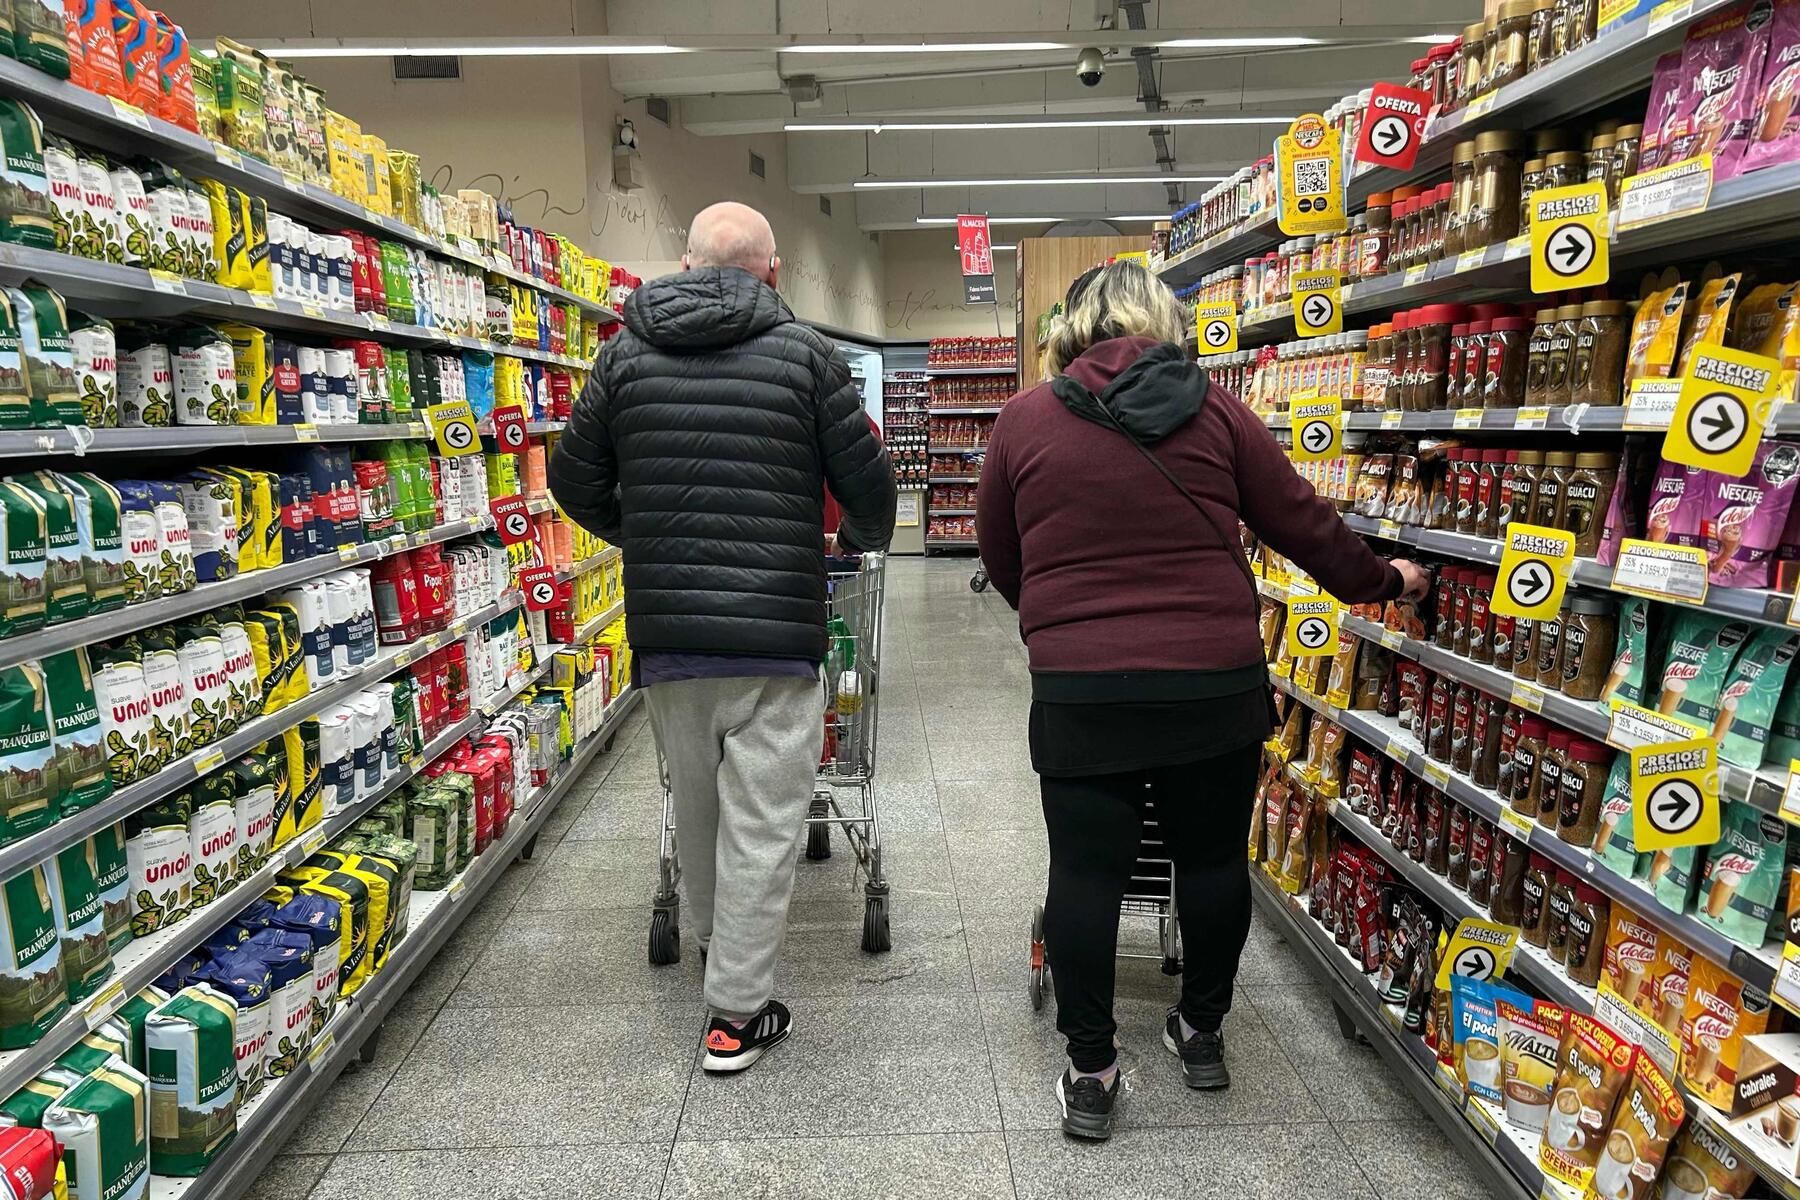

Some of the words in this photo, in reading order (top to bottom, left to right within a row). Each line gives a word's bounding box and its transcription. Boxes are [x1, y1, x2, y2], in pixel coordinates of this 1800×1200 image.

[1374, 96, 1422, 116] OFERTA
[498, 412, 522, 422] OFERTA
[496, 501, 524, 513] OFERTA
[525, 572, 553, 583] OFERTA
[1667, 663, 1697, 677] dolca
[76, 703, 84, 711] LA
[21, 724, 30, 732] LA
[109, 863, 116, 872] LA
[1720, 857, 1754, 873] dolca
[86, 892, 94, 901] LA
[35, 927, 44, 938] LA
[1463, 1012, 1471, 1027] El
[1472, 1021, 1497, 1038] poci
[1699, 1019, 1731, 1036] dolca
[1570, 1013, 1594, 1033] PACK
[1594, 1029, 1616, 1052] OFERTA
[1569, 1048, 1578, 1065] El
[1638, 1055, 1651, 1073] ACK
[222, 1067, 229, 1075] LA
[1740, 1073, 1776, 1099] Cabrales
[124, 1161, 133, 1171] LA
[1544, 1150, 1582, 1179] OFERTA
